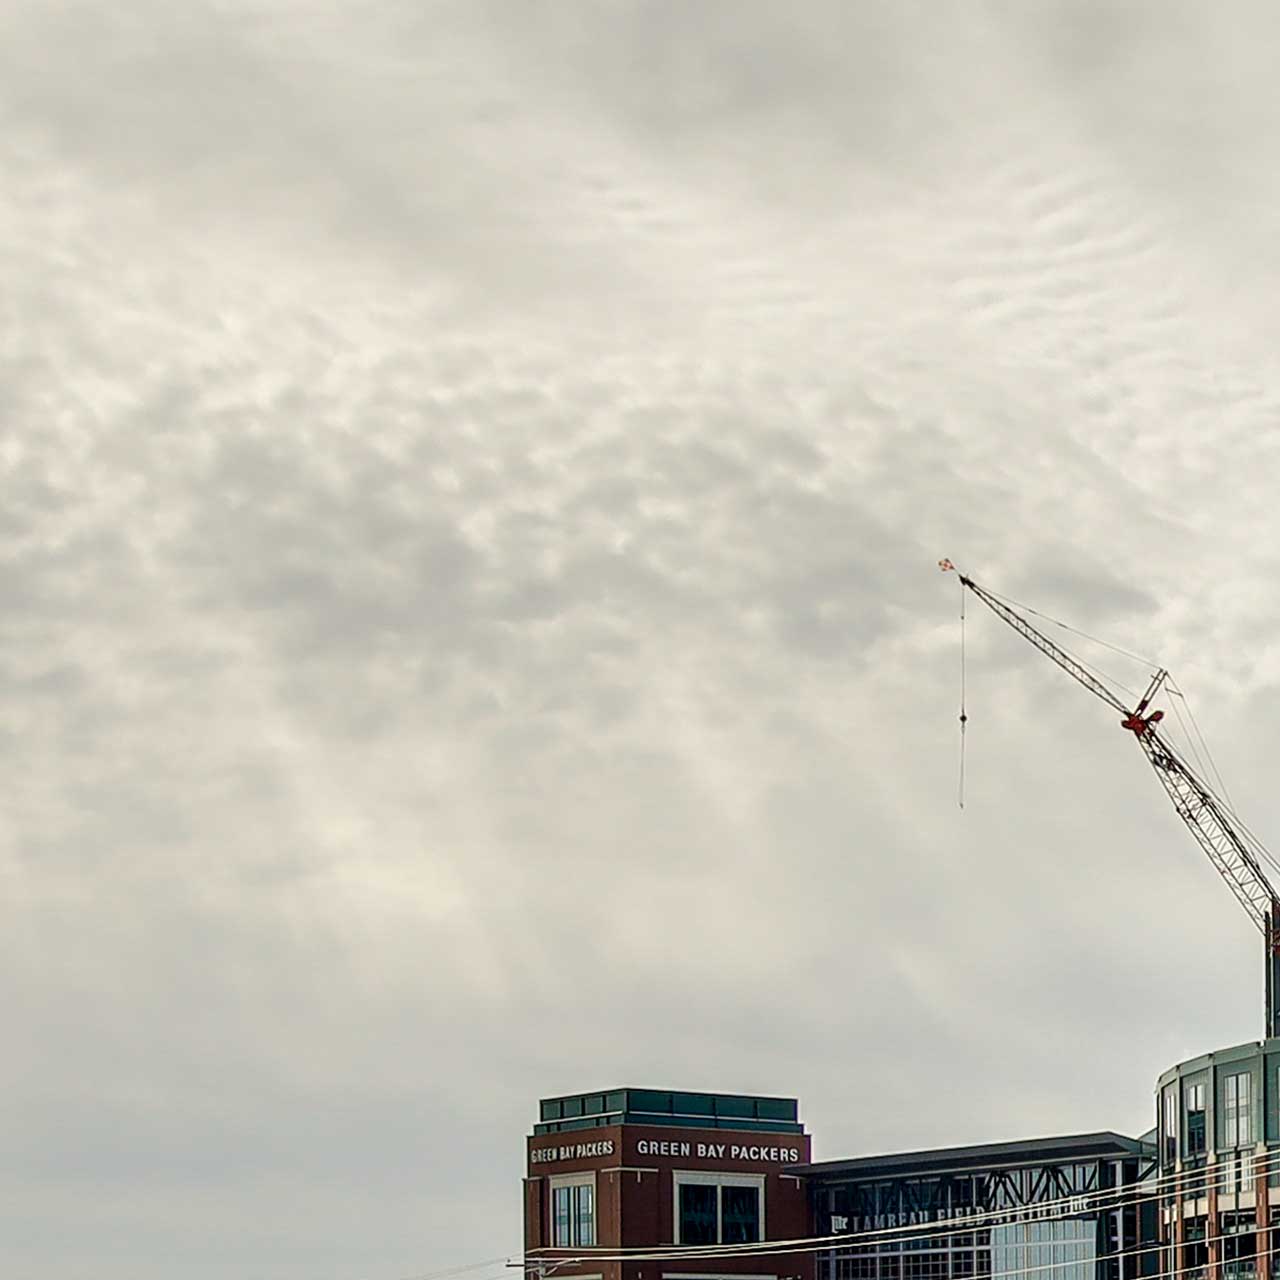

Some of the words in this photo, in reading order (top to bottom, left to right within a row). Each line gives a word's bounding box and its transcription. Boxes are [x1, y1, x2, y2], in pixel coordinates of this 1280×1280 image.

[531, 1143, 558, 1164] GREEN
[559, 1144, 575, 1161] BAY
[576, 1139, 614, 1160] PACKERS
[637, 1140, 690, 1158] GREEN
[697, 1143, 725, 1160] BAY
[731, 1145, 799, 1163] PACKERS
